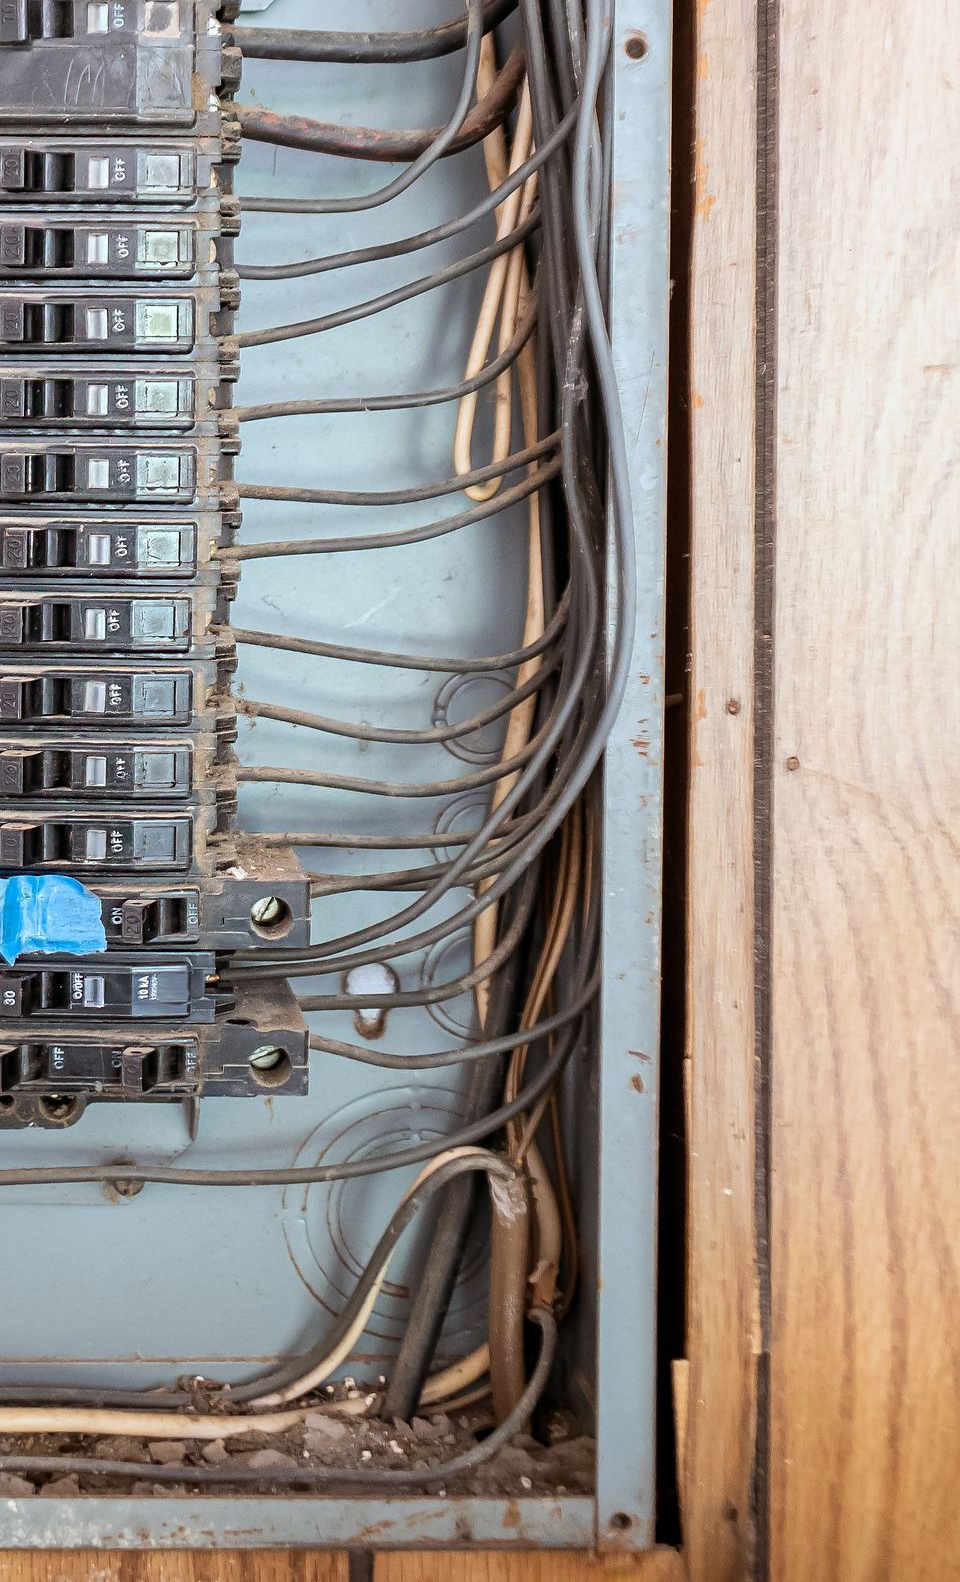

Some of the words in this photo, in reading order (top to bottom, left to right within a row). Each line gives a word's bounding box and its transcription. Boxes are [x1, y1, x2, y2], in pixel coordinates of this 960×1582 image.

[113, 3, 124, 28] OFF
[113, 157, 126, 182] OFF
[116, 235, 130, 259] OFF
[112, 308, 125, 332] OFF
[116, 385, 129, 409] OFF
[115, 535, 128, 557] OFF
[107, 609, 121, 632] OFF
[111, 830, 123, 853] OFF
[111, 907, 122, 925] ON
[189, 903, 199, 925] OFF
[138, 975, 149, 990] kA
[3, 990, 16, 1006] 30
[138, 990, 149, 1000] 10
[53, 1047, 65, 1069] OFF
[111, 1050, 122, 1068] ON
